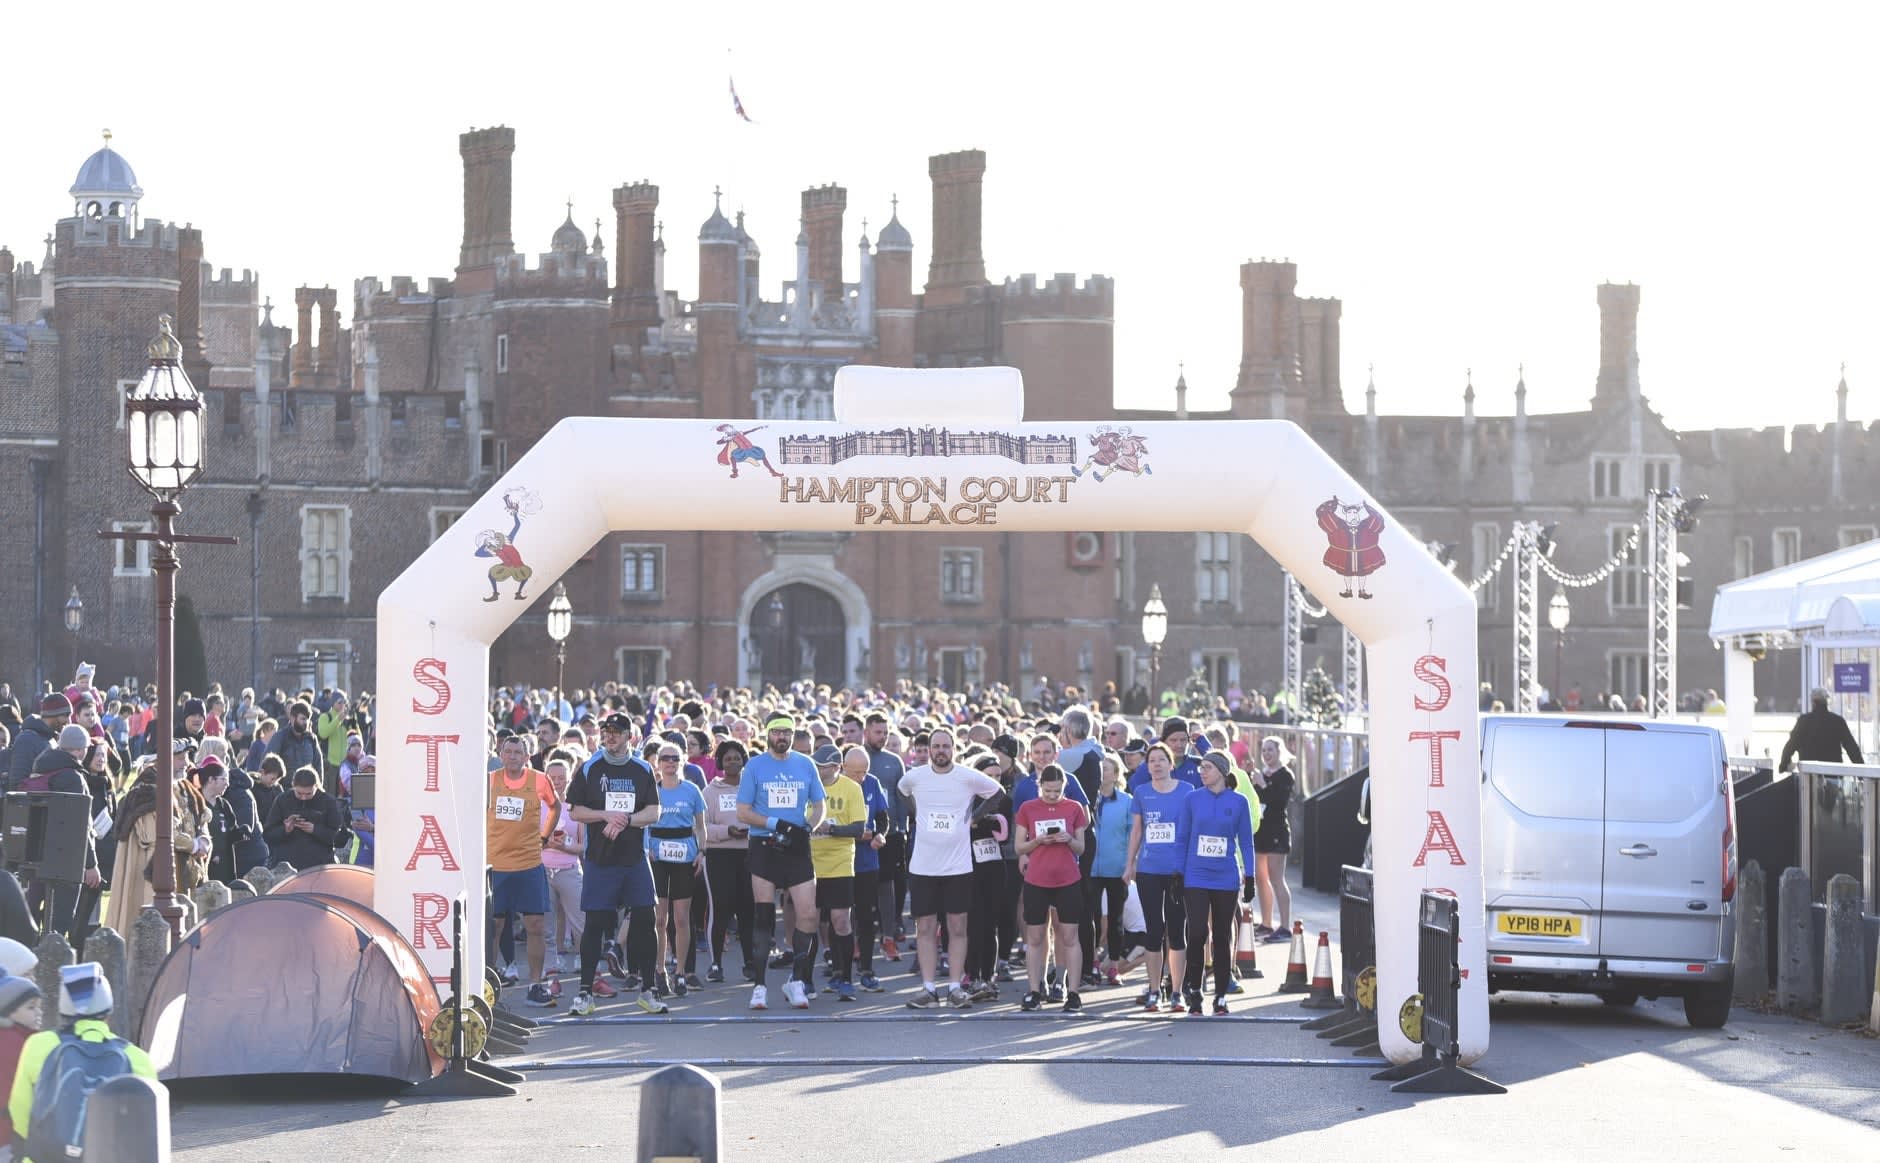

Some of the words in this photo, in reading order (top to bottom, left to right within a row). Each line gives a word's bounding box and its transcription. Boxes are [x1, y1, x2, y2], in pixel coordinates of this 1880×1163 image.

[779, 476, 947, 503] HAMPTON
[959, 476, 1076, 503] COURT
[854, 503, 997, 525] PALACE
[612, 800, 629, 809] 755
[775, 796, 790, 805] 141
[496, 805, 522, 816] 3936
[404, 657, 460, 984] STAR
[933, 821, 950, 830] 204
[1150, 831, 1171, 840] 2238
[663, 848, 684, 859] 1440
[979, 846, 997, 856] 1487
[1202, 844, 1223, 854] 1675
[1507, 916, 1540, 931] YP18
[1543, 918, 1572, 932] HPA
